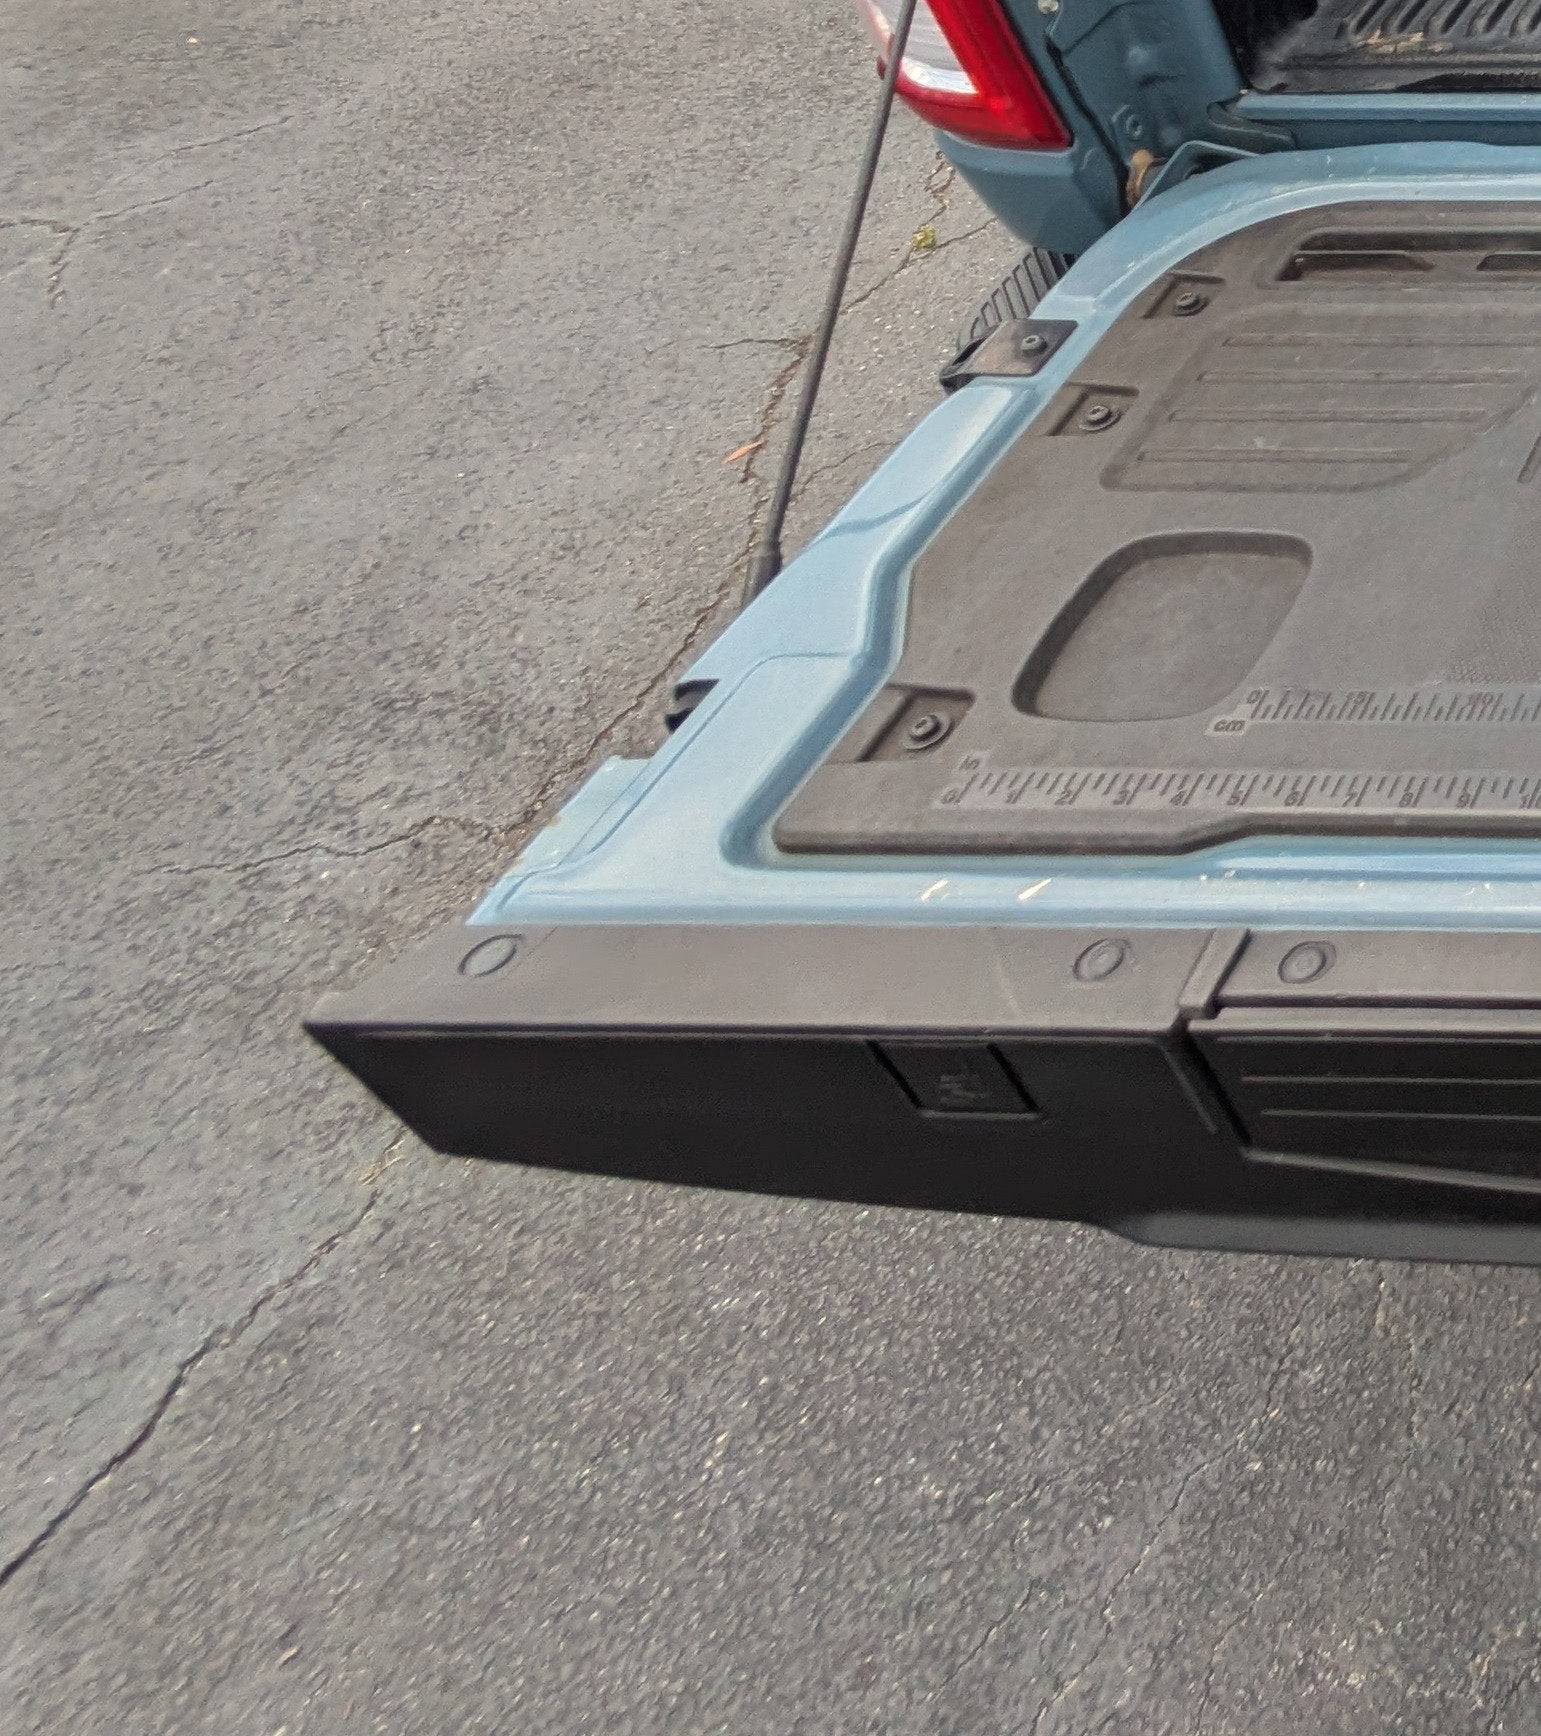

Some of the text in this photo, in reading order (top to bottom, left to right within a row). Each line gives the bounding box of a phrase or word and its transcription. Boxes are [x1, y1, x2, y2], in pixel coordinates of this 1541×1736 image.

[1213, 718, 1246, 733] cm
[1054, 790, 1073, 805] 2
[1112, 790, 1130, 805] 3
[1168, 790, 1186, 806] 4
[1226, 790, 1243, 806] 5
[1283, 791, 1300, 807] 6
[1342, 791, 1359, 808] 7
[1399, 792, 1414, 808] 8
[1456, 793, 1471, 809] 9
